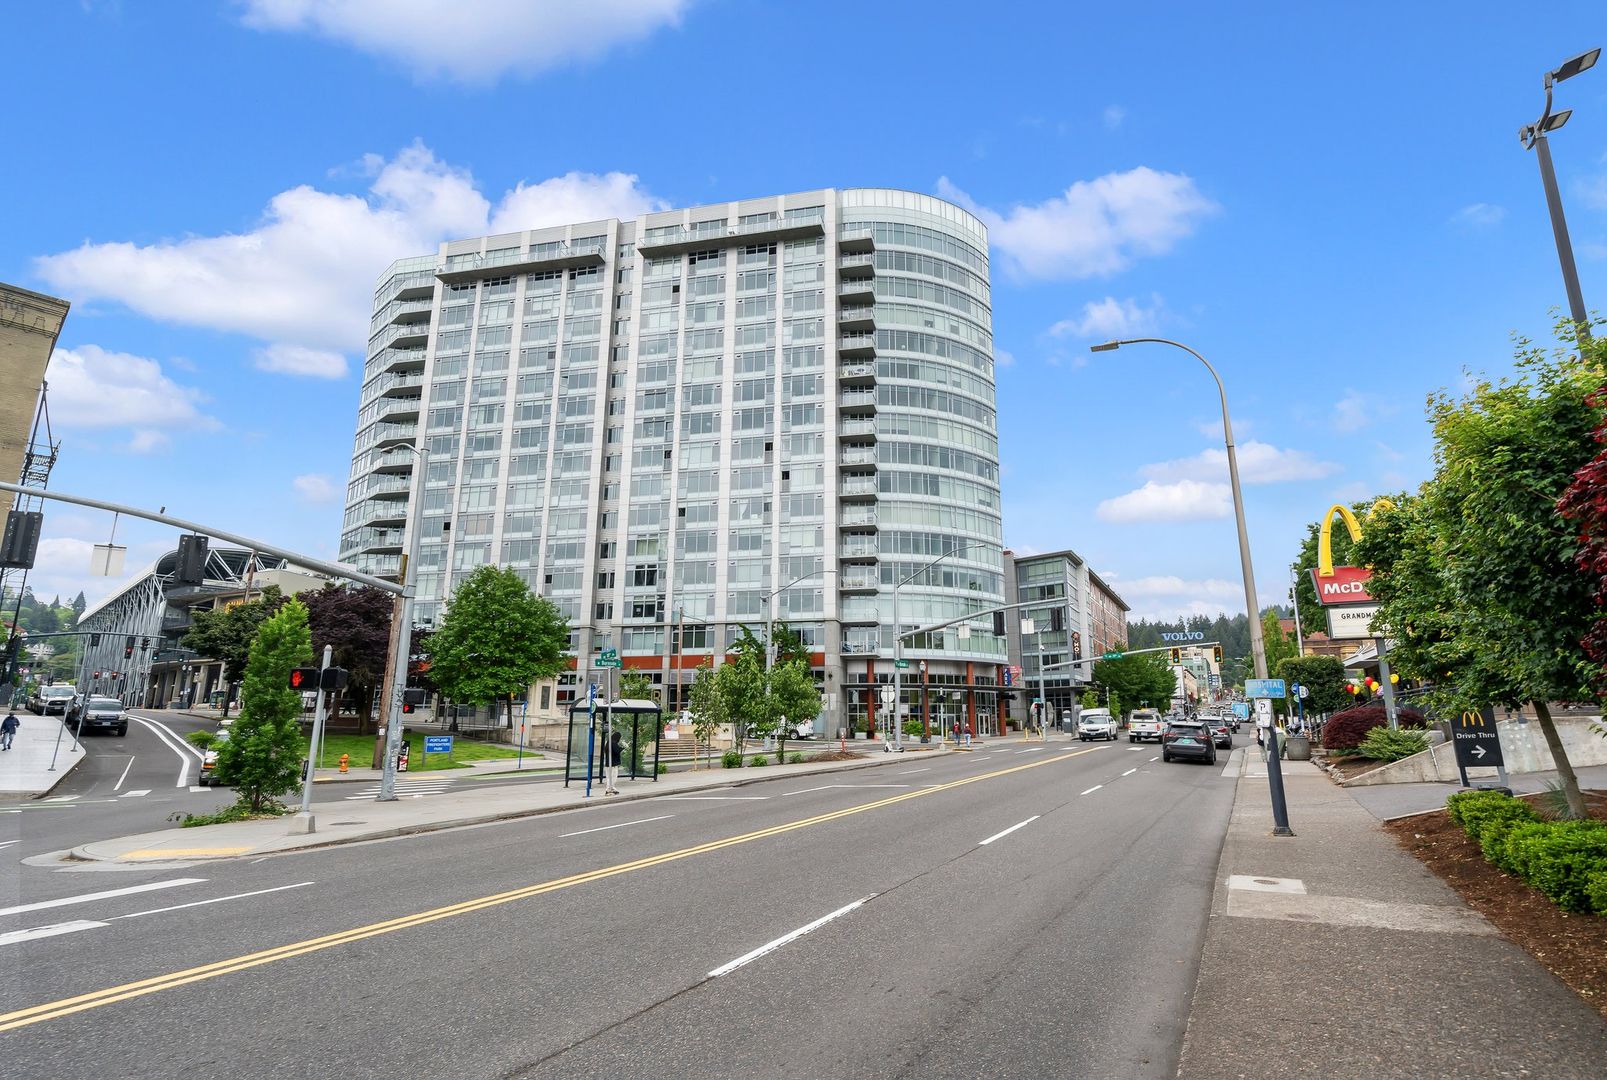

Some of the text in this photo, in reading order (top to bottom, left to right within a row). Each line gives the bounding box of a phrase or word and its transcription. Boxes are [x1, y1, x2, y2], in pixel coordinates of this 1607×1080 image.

[1324, 581, 1364, 594] McD
[1161, 631, 1204, 641] VOLVO
[1250, 681, 1283, 689] SPITAL
[1478, 731, 1496, 739] Thru
